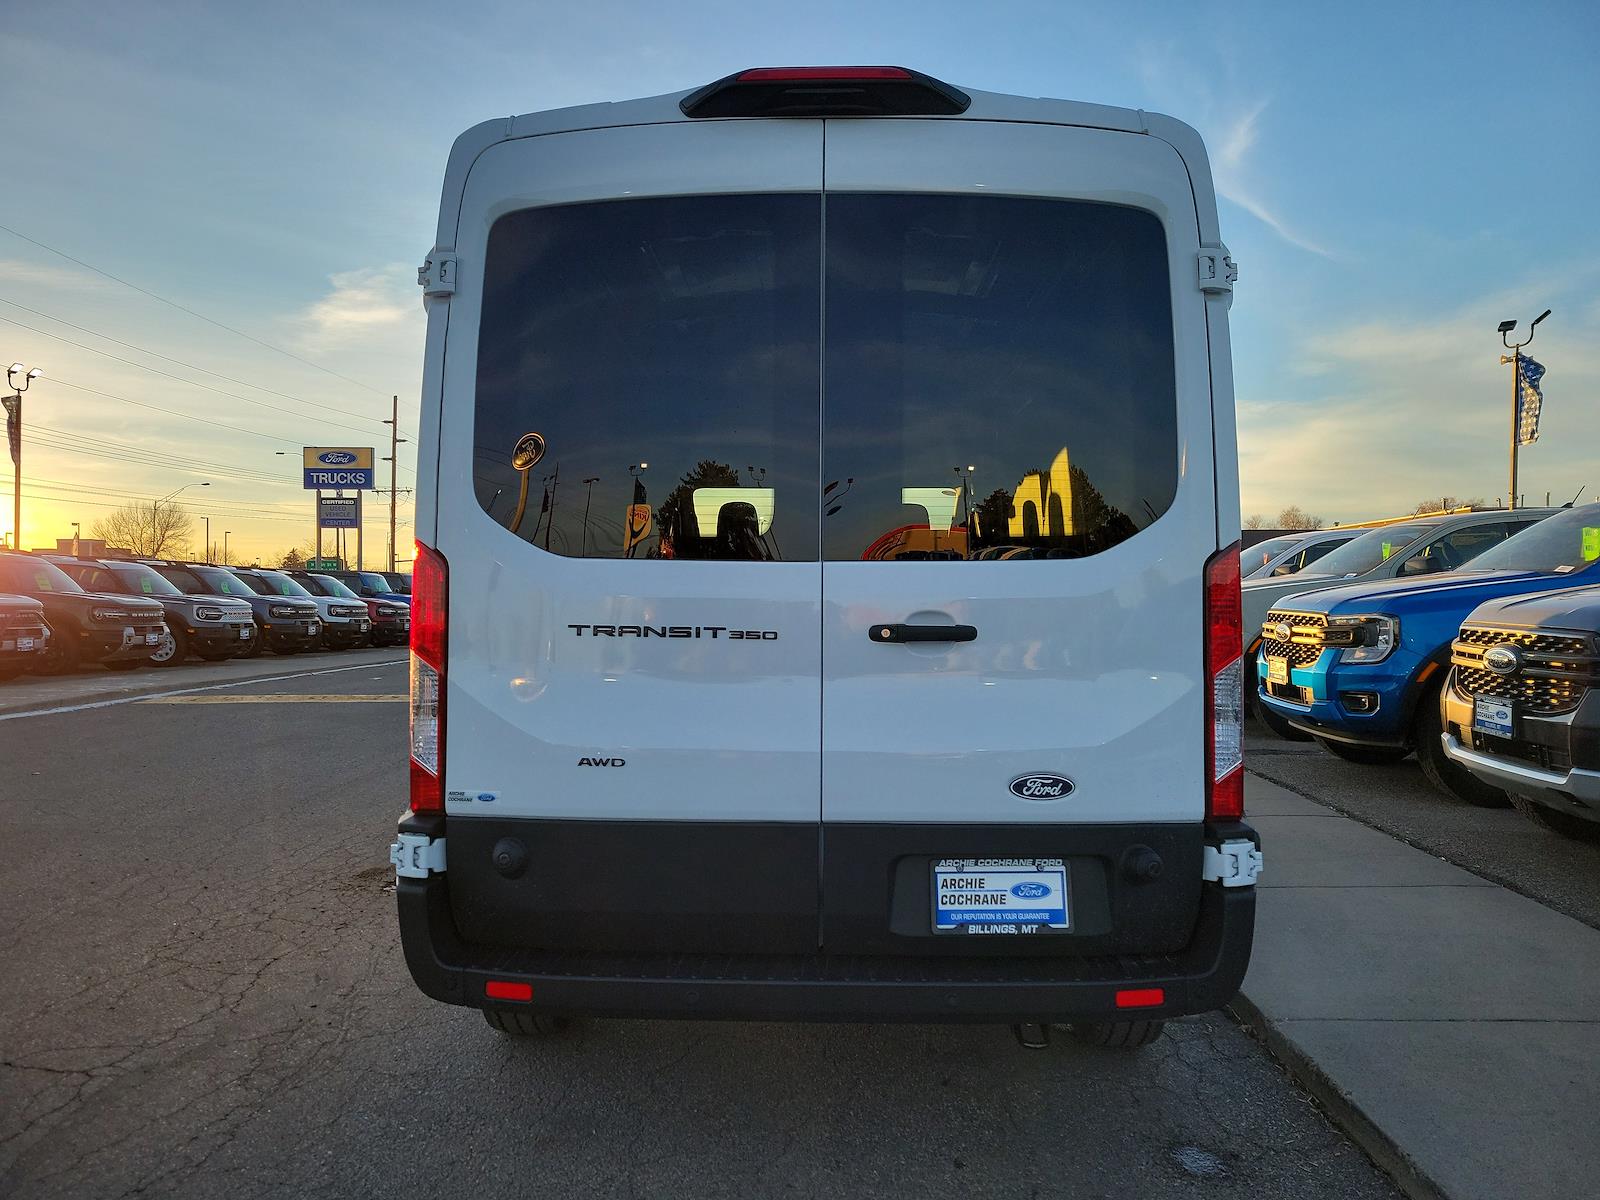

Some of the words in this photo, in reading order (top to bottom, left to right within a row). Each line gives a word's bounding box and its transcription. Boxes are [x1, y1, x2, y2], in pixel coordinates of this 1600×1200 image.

[325, 453, 350, 464] Ford
[310, 472, 366, 484] TRUCKS
[577, 757, 626, 767] AWD
[1022, 778, 1063, 796] Ford
[939, 859, 976, 867] ARCHIE
[941, 878, 985, 889] ARCHIE
[1018, 885, 1043, 897] Ford
[941, 894, 1007, 905] COCHRANE
[968, 925, 1019, 935] BILLINGS,
[1021, 925, 1039, 934] MT
